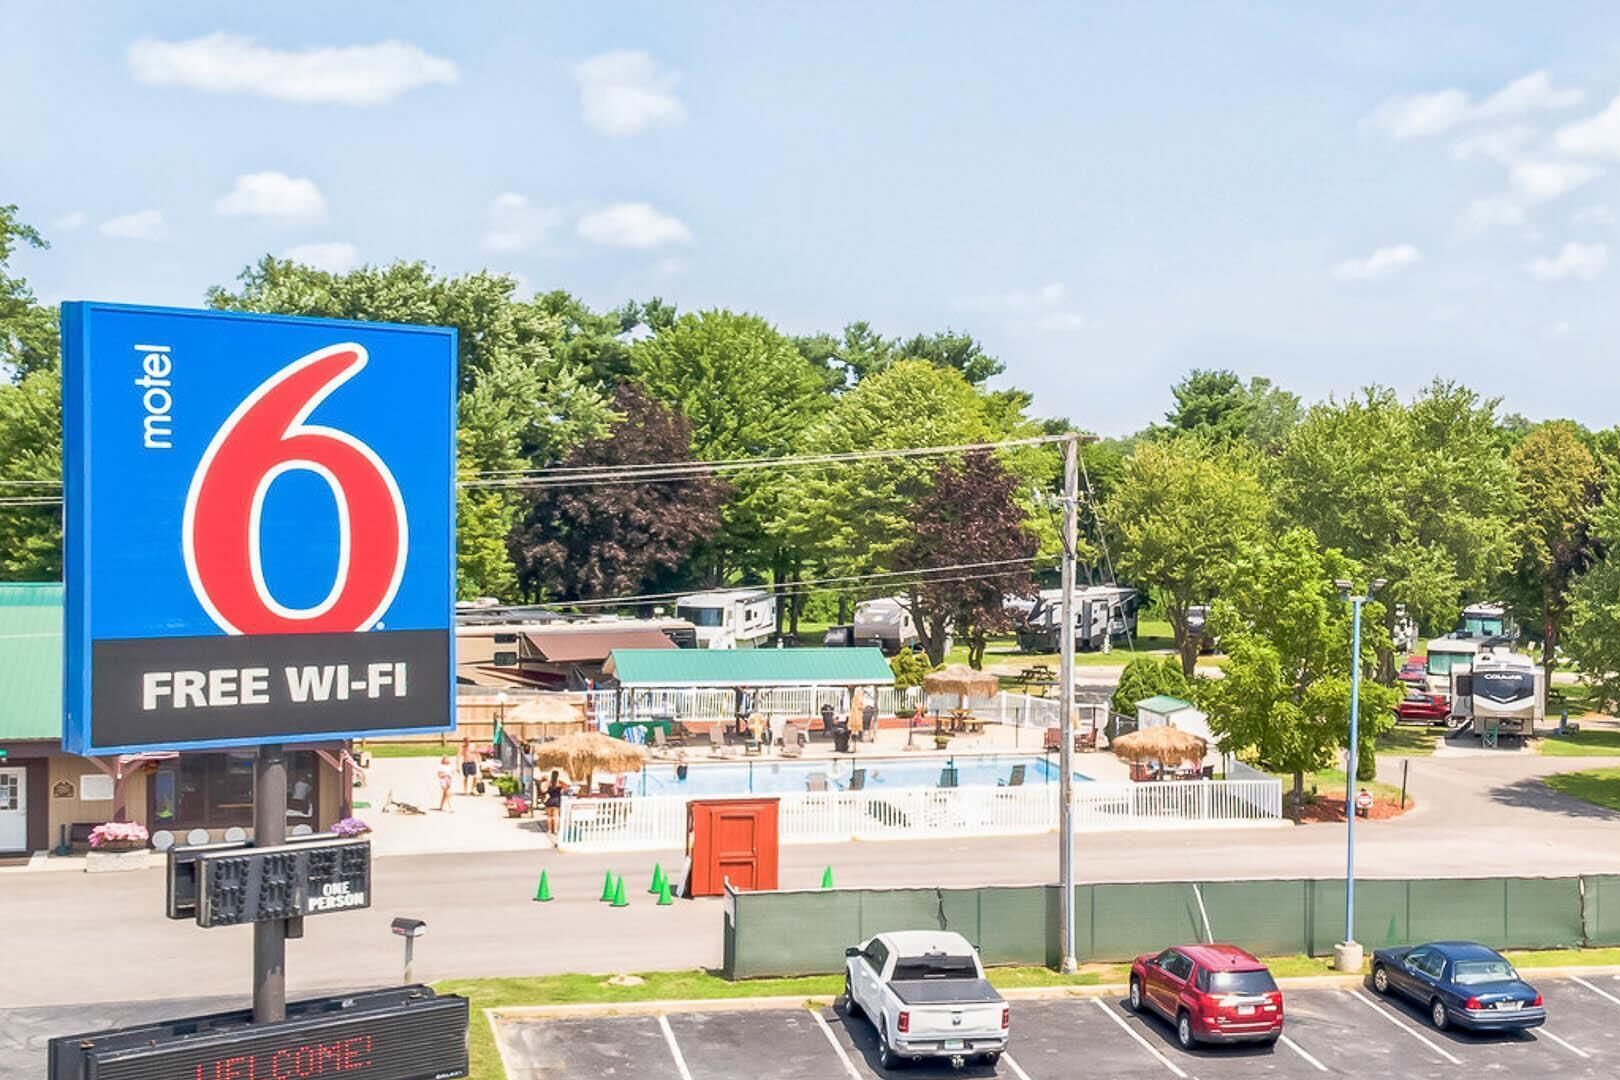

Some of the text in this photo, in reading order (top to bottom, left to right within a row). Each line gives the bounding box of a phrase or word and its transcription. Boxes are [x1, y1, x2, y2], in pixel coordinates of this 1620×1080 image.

[135, 342, 408, 635] motel 6
[143, 662, 406, 709] FREE WI-FI
[309, 893, 364, 911] PERSON
[323, 881, 350, 896] ONE
